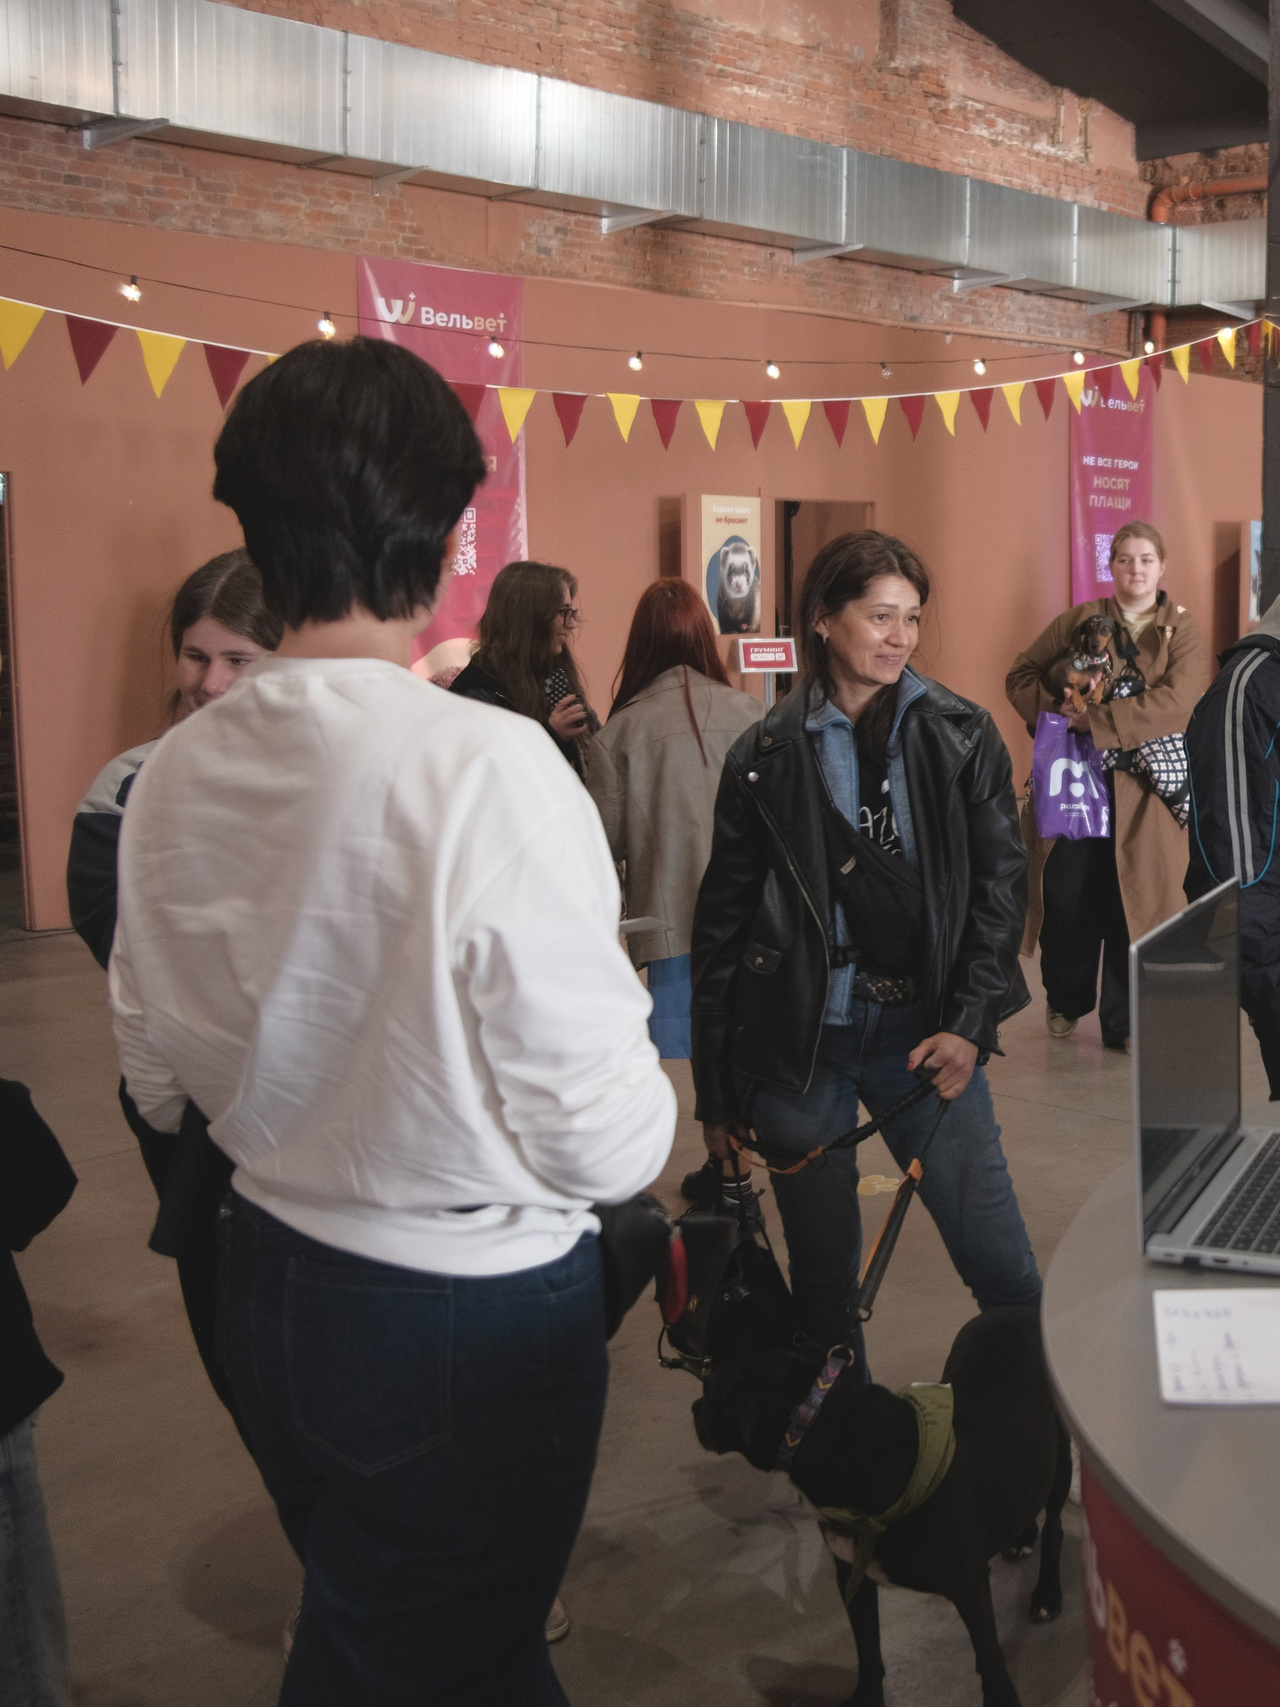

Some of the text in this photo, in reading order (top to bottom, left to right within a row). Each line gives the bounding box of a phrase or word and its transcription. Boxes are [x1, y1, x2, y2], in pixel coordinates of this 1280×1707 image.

[421, 306, 507, 333] Вельвет
[1083, 456, 1139, 470] НЕ ВСЕ ГЕРОИ
[1093, 476, 1131, 491] НОСЯТ
[1089, 494, 1132, 511] ПЛАЩИ
[723, 515, 749, 525] бросают
